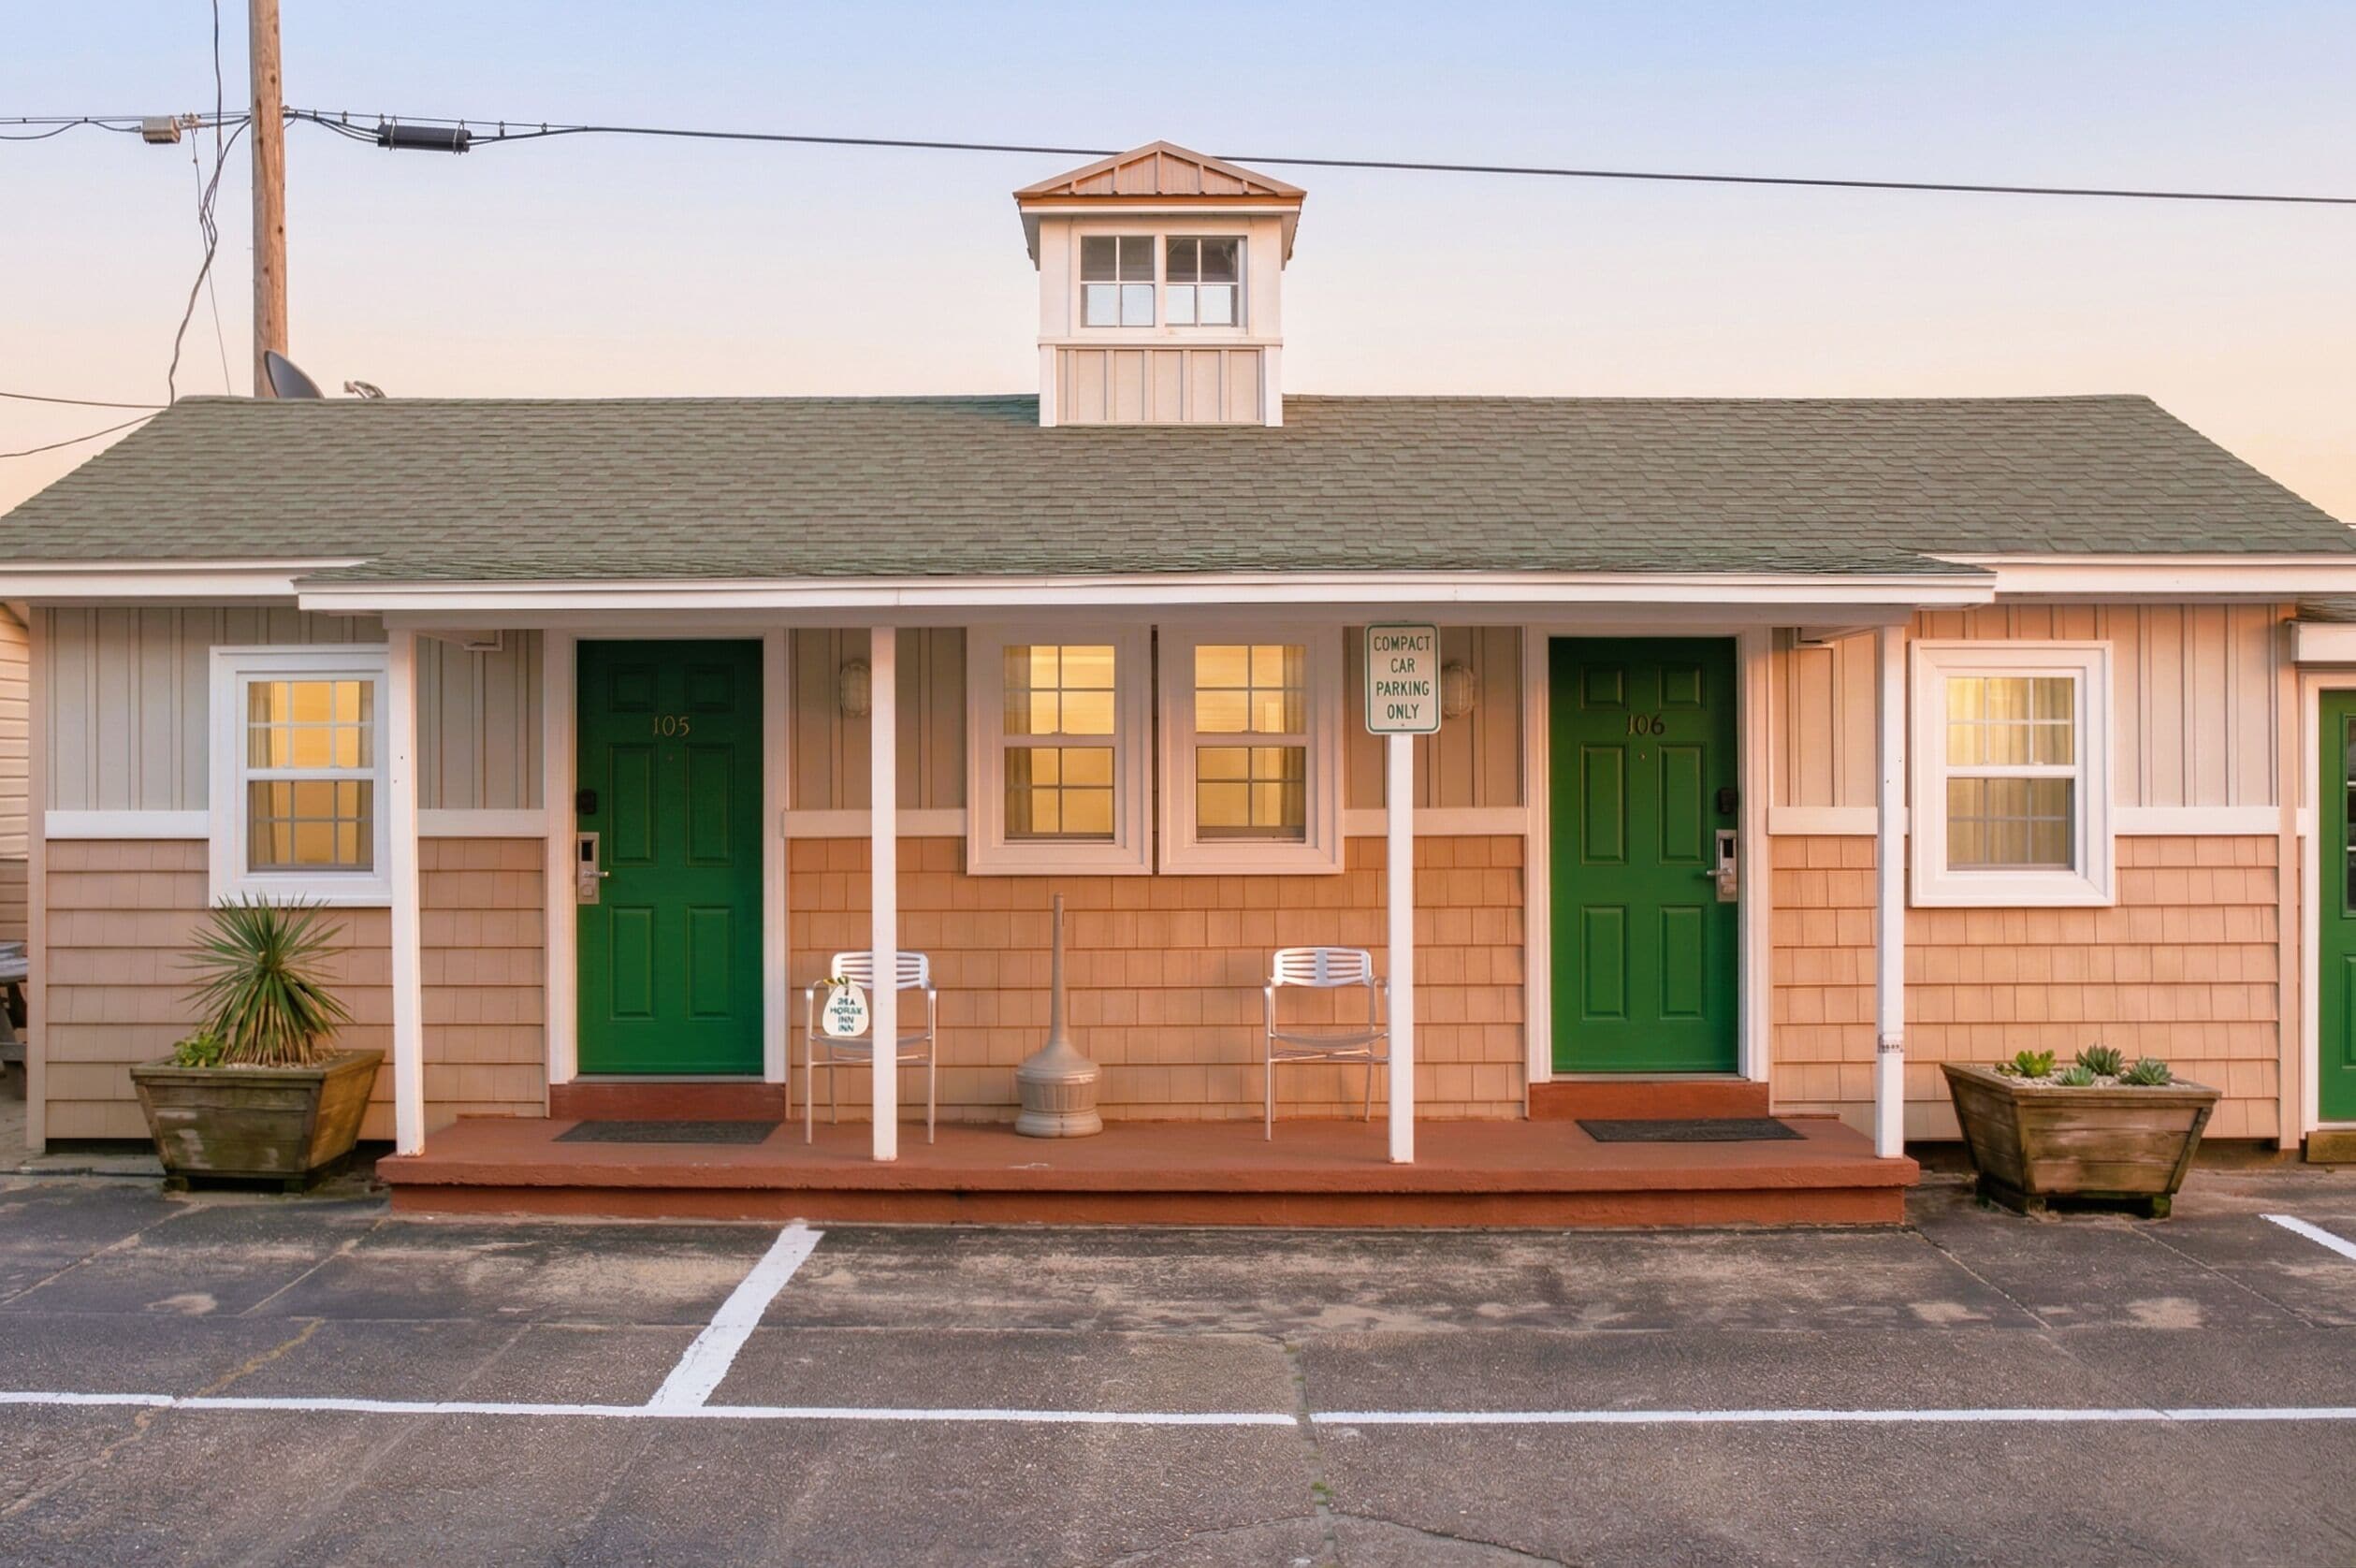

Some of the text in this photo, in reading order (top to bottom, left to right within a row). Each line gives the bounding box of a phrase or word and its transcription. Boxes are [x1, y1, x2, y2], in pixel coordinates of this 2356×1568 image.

[1374, 636, 1431, 651] COMPACT
[1390, 658, 1415, 673] CAR
[1376, 681, 1430, 696] PARKING
[1387, 704, 1419, 719] ONLY
[654, 715, 690, 737] 105
[1626, 714, 1665, 736] 106
